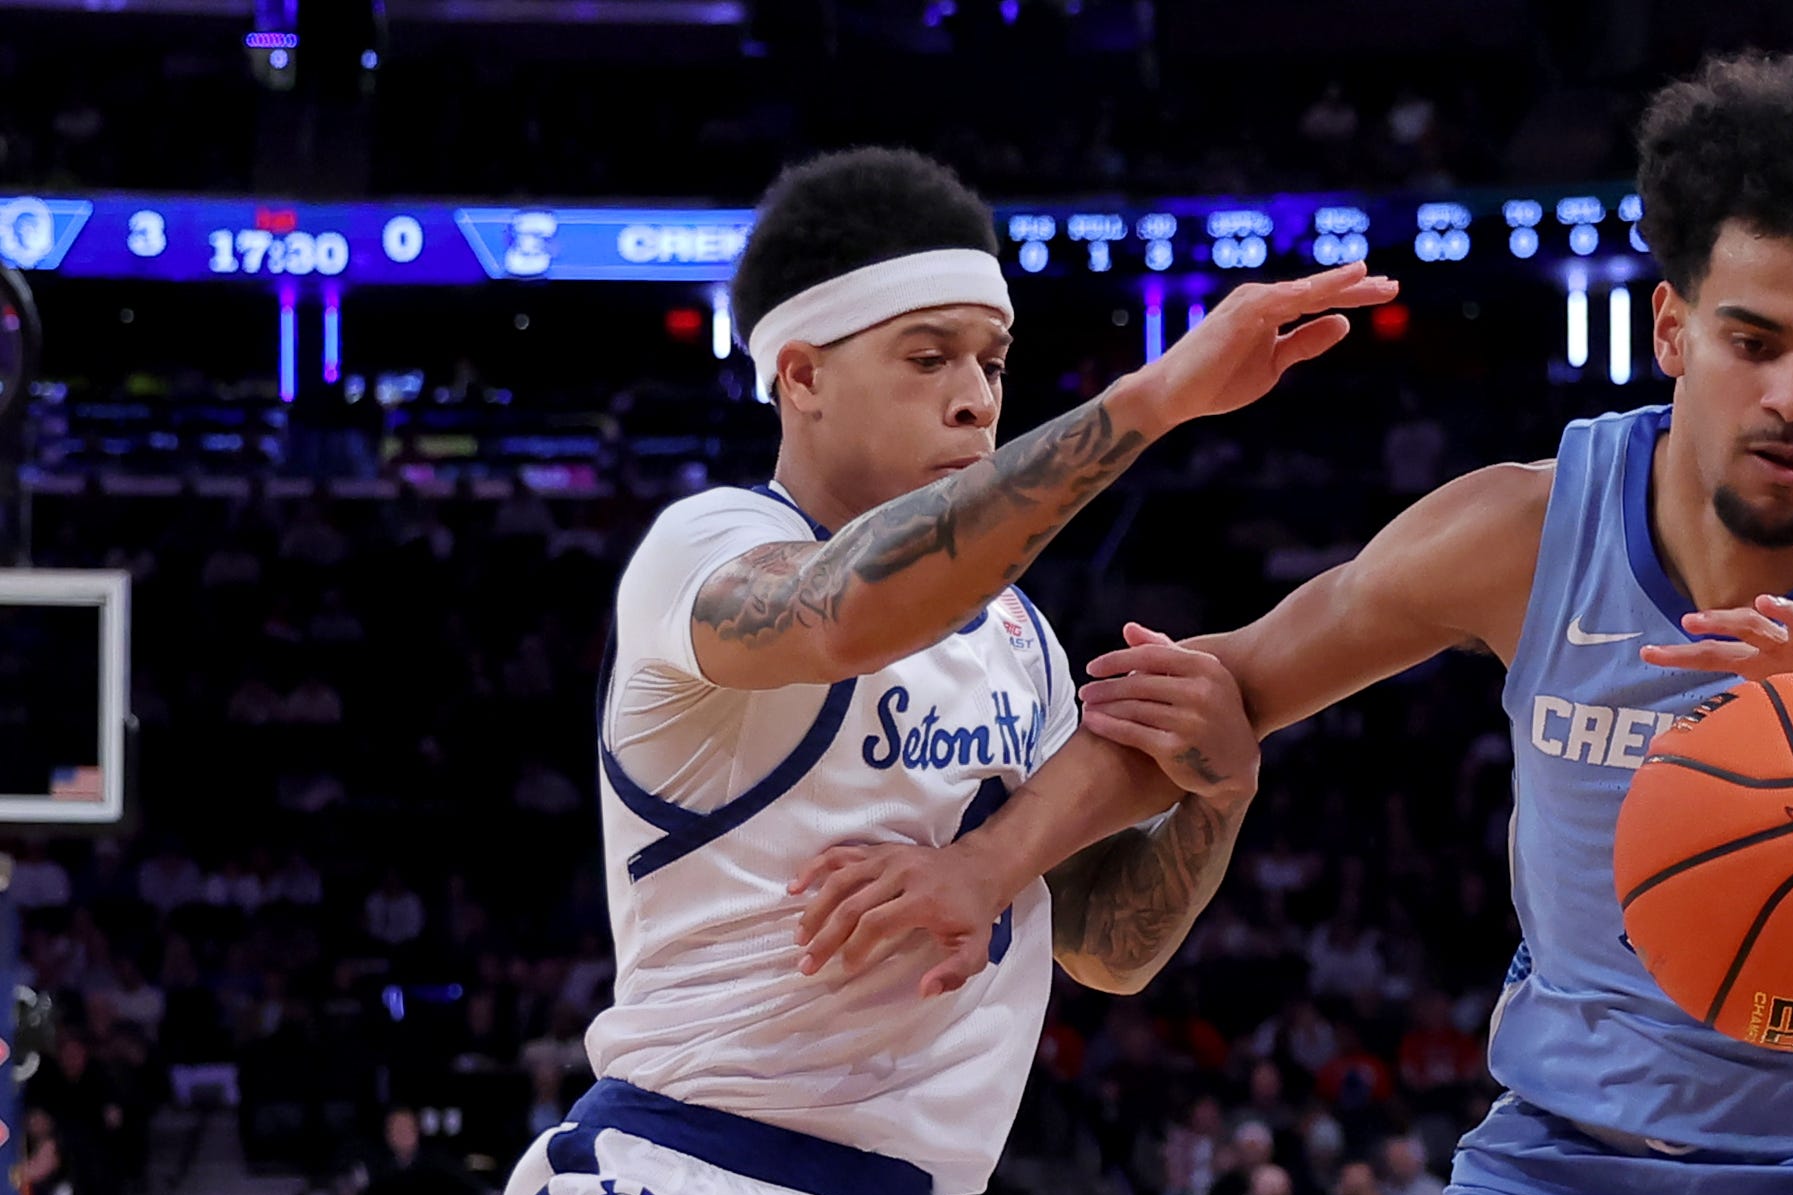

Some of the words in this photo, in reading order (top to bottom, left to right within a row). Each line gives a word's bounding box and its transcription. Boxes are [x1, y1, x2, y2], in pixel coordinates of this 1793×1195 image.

[127, 210, 168, 257] 3
[208, 230, 350, 276] 17:30
[382, 216, 424, 263] 0
[862, 685, 995, 770] Seton
